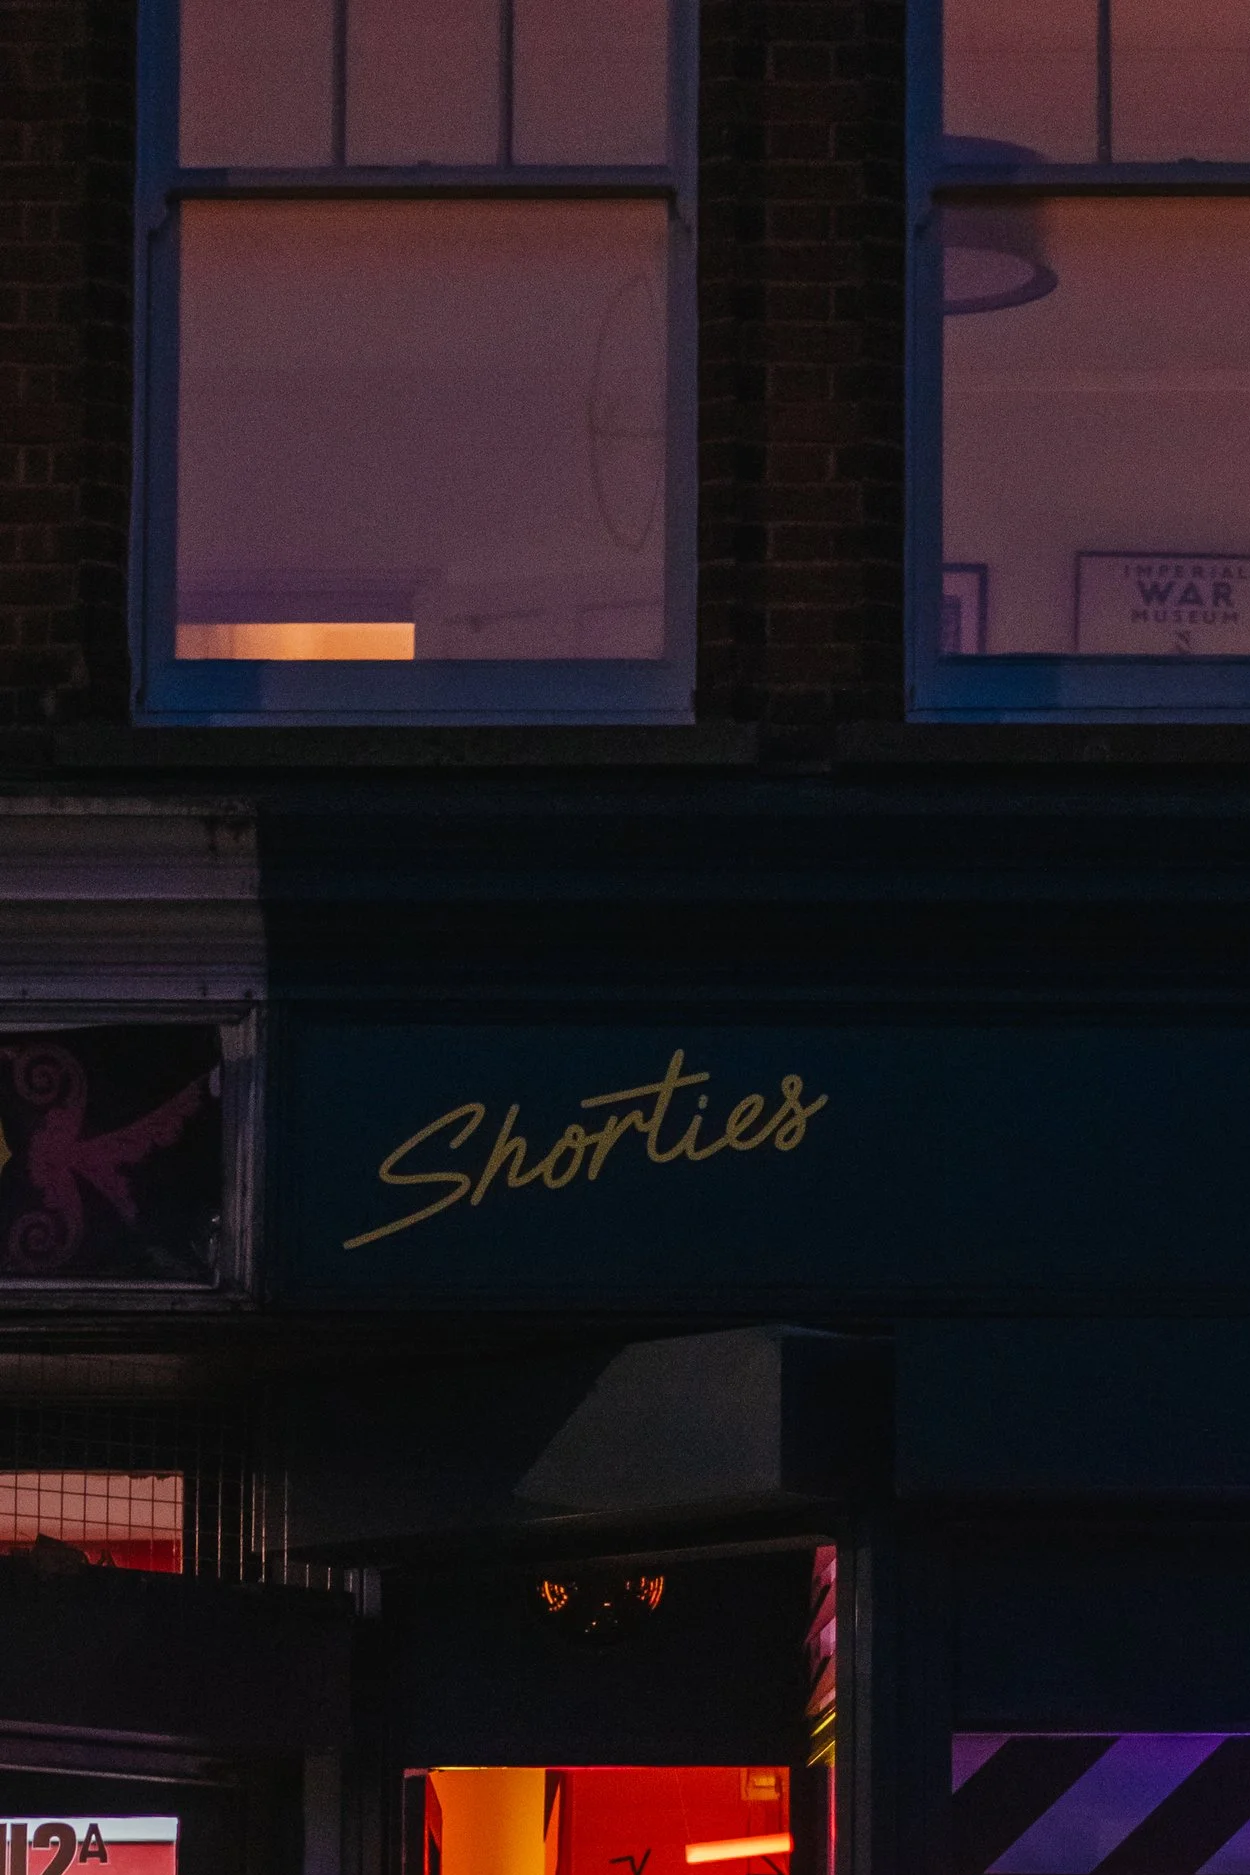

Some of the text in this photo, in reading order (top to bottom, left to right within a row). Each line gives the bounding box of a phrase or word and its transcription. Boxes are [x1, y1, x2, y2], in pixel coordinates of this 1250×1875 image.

[1124, 565, 1247, 579] IMPERIAL
[1137, 580, 1234, 607] WAR
[1131, 609, 1239, 624] MUSEUM
[343, 1048, 830, 1250] Shorties
